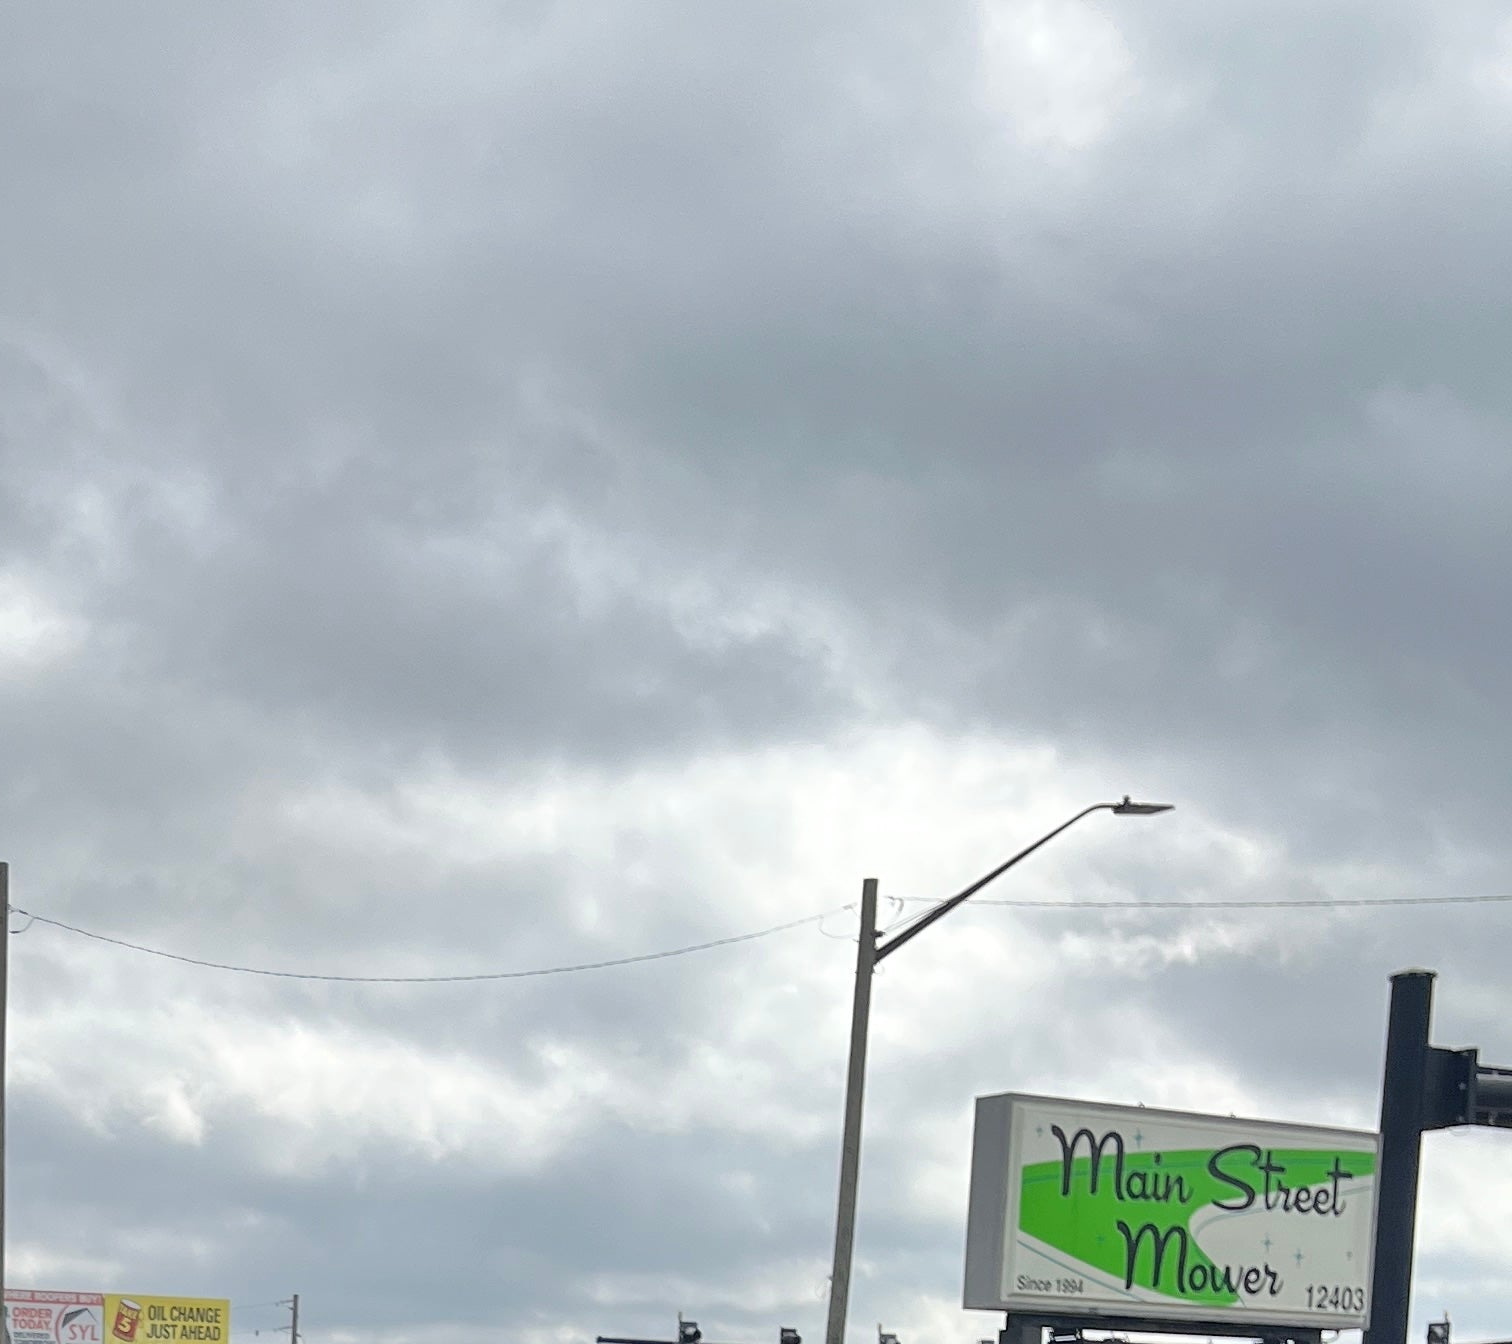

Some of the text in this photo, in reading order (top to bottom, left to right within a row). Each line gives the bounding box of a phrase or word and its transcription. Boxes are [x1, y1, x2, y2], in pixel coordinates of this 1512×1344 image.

[1051, 1124, 1354, 1216] Main Street
[1116, 1220, 1284, 1297] Mower
[1017, 1274, 1085, 1294] Since 1994
[1305, 1285, 1364, 1312] 12403
[12, 1307, 52, 1319] ORDER
[148, 1305, 222, 1324] OIL CHANGE
[69, 1324, 100, 1341] SYL
[118, 1317, 132, 1333] 5
[146, 1323, 222, 1341] JUST AHEAD
